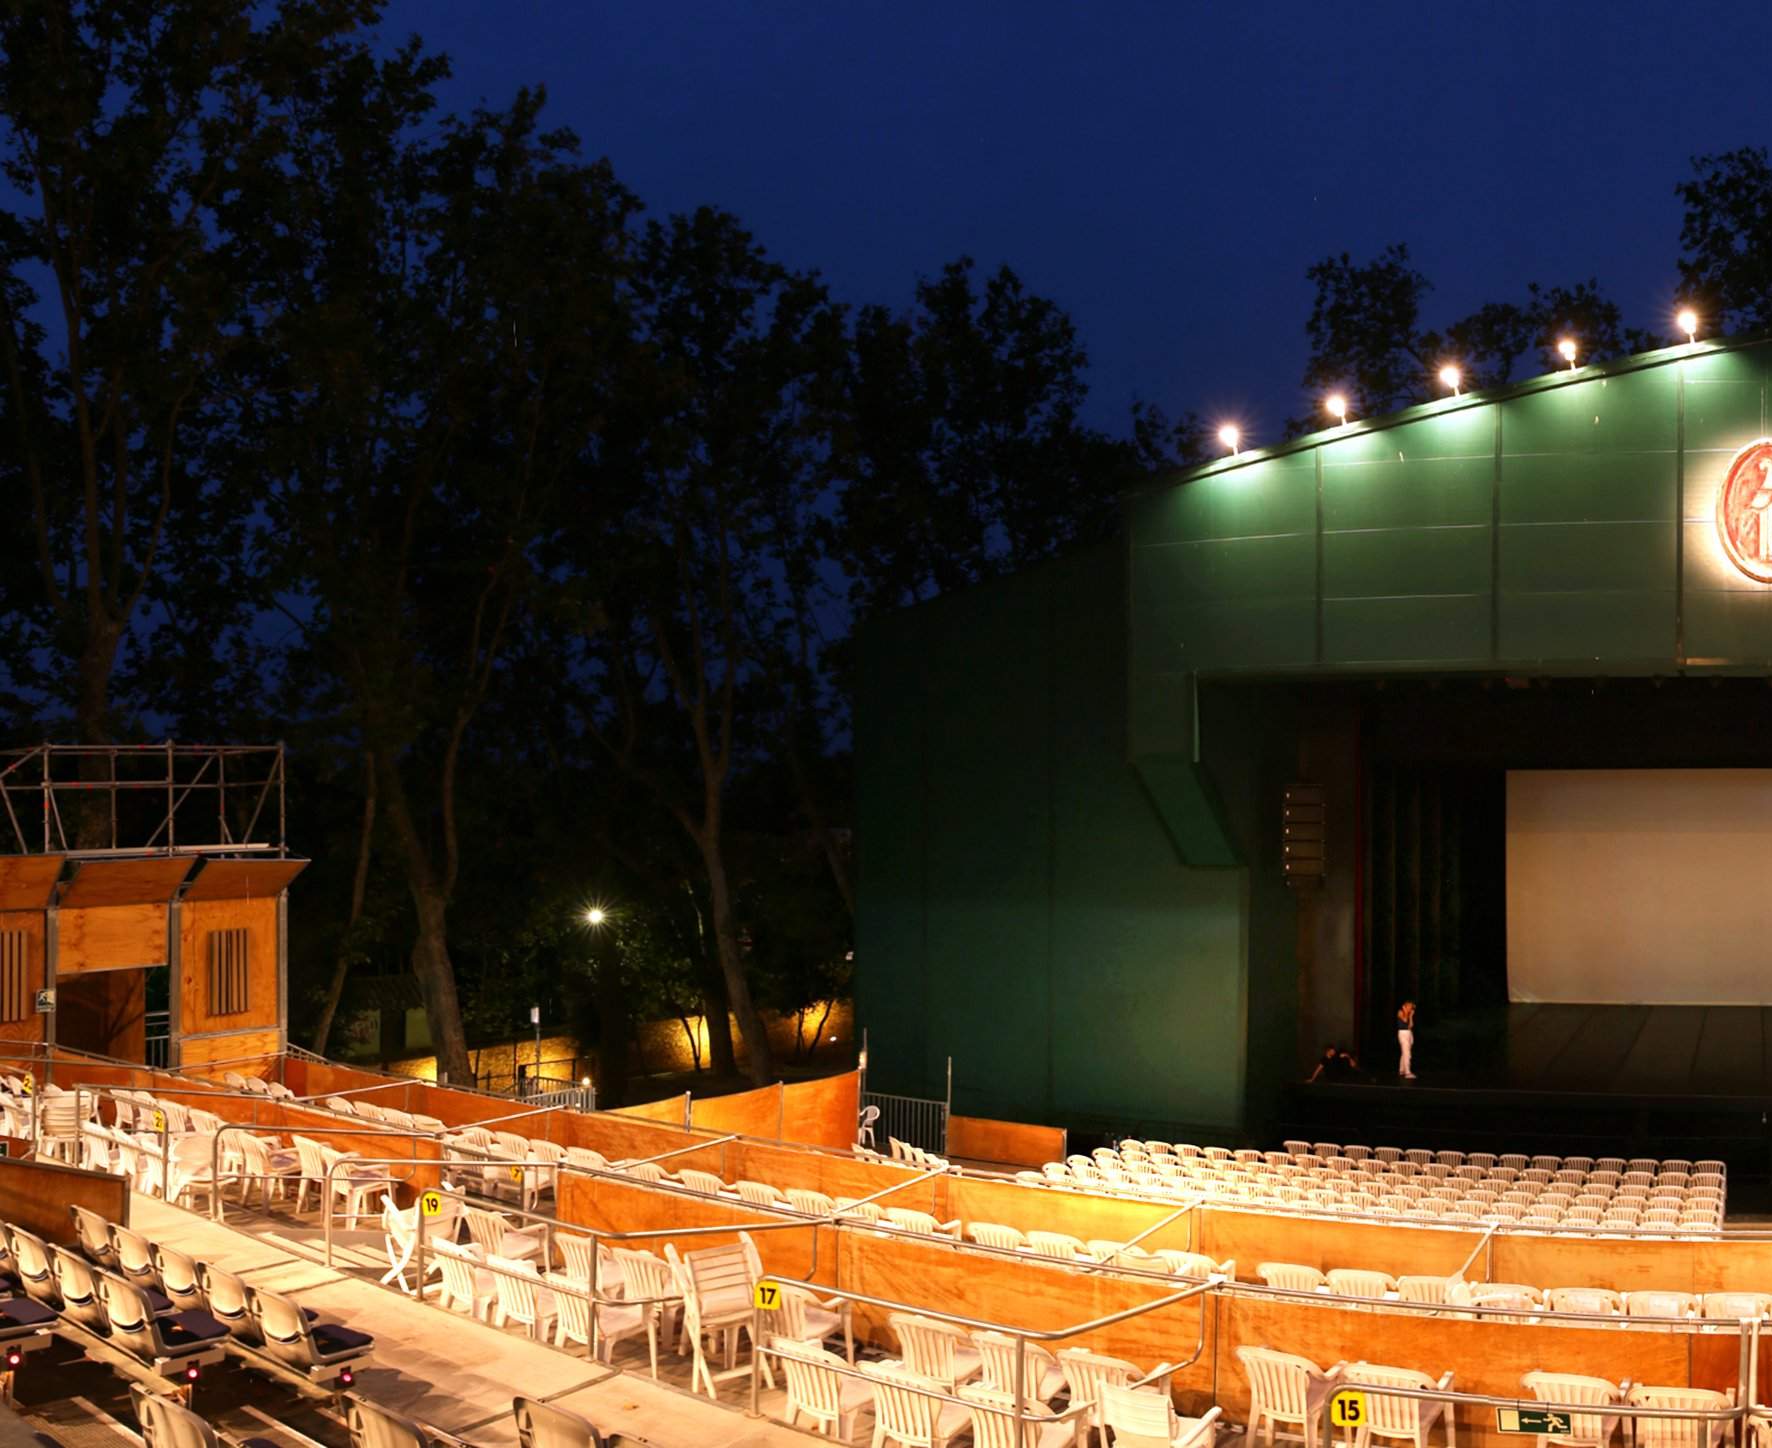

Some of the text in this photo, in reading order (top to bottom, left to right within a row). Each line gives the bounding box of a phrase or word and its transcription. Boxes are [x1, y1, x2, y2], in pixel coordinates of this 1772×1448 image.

[426, 1198, 438, 1212] 19
[760, 1287, 776, 1304] 17
[1338, 1399, 1360, 1421] 15
